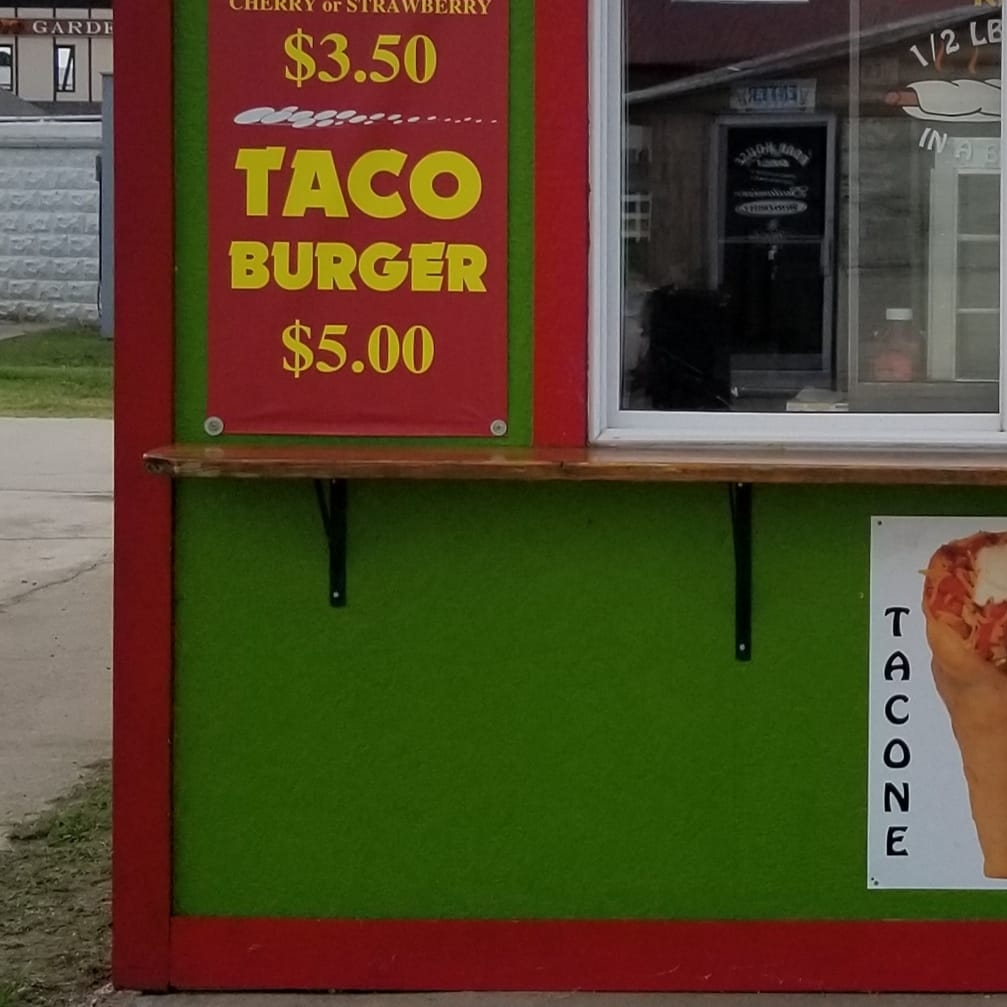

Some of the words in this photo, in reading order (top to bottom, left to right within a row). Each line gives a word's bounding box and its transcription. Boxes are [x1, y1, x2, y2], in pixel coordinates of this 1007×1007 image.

[322, 0, 342, 13] or
[283, 28, 437, 88] $3.50
[919, 127, 948, 153] IN
[234, 146, 482, 220] TACO
[228, 241, 487, 292] BURGER
[281, 319, 434, 378] $5.00
